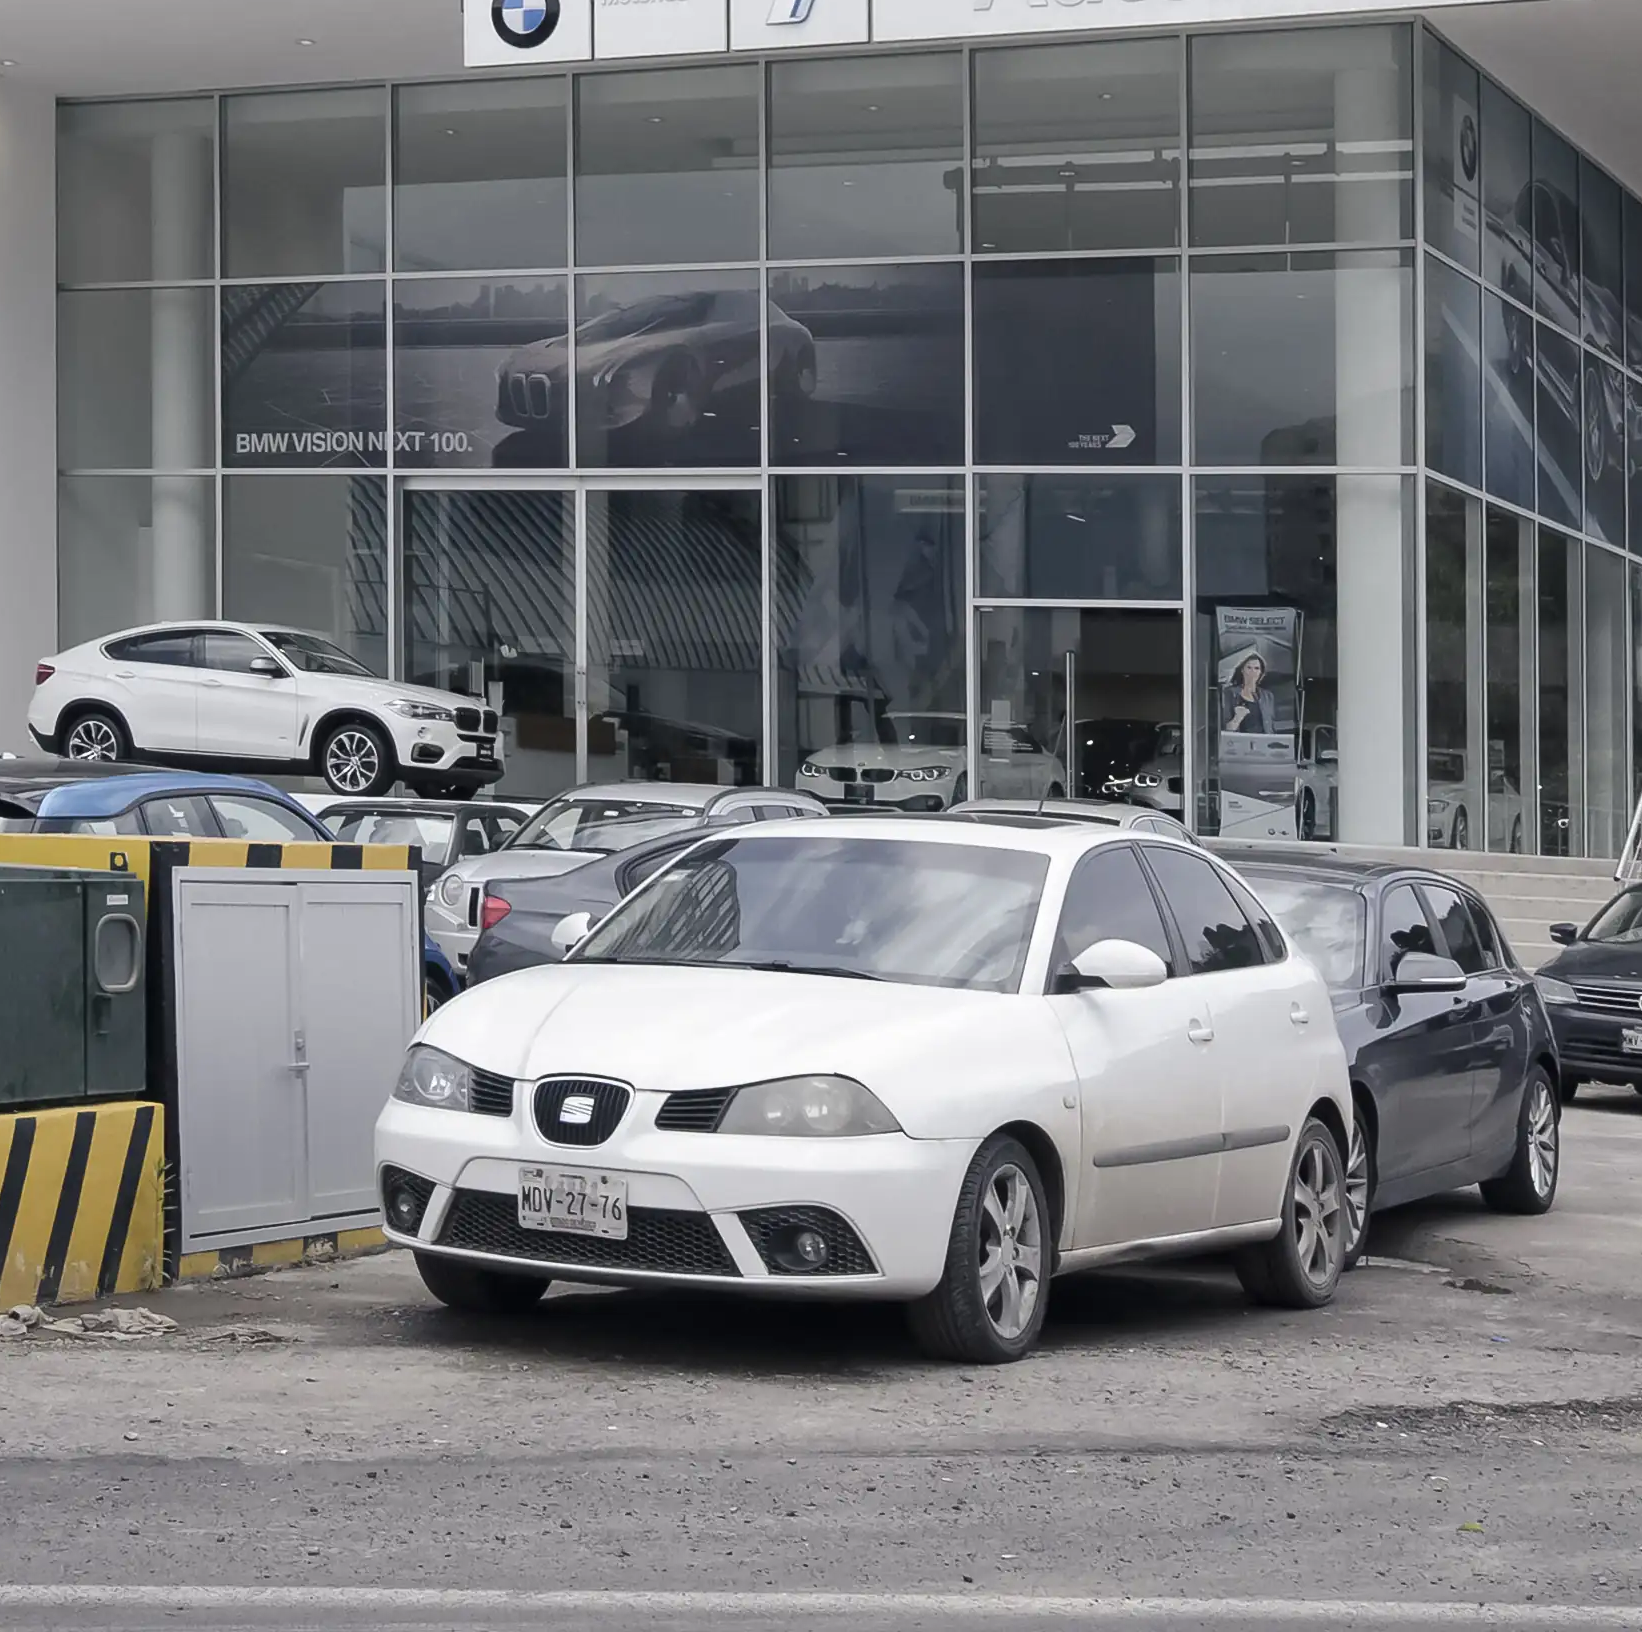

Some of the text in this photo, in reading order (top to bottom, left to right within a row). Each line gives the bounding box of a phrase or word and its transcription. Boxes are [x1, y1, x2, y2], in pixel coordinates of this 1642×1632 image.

[236, 433, 288, 453] BMW
[293, 431, 363, 452] VISION
[429, 432, 473, 452] 100.
